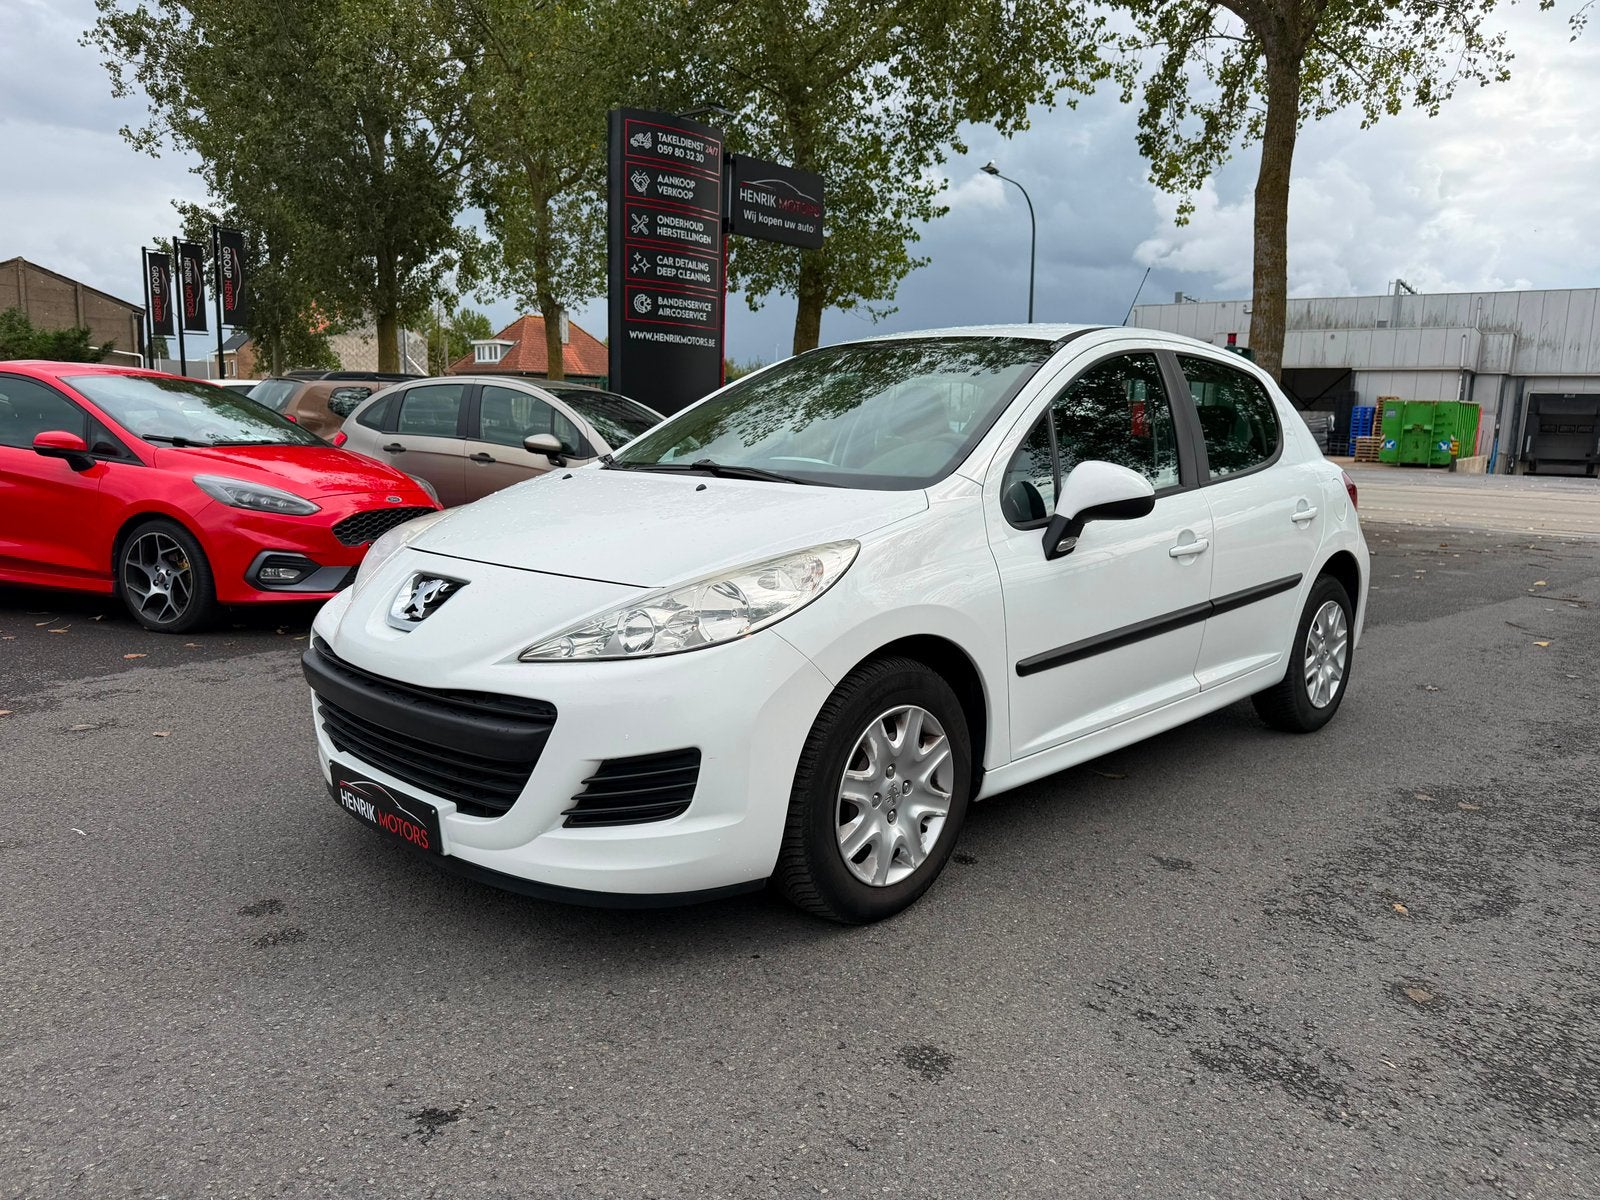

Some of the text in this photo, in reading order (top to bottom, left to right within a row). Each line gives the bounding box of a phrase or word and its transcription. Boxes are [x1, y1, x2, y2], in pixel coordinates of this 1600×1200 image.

[657, 132, 704, 151] TAKELDIENST
[657, 144, 705, 163] 059 80 32 30
[657, 174, 696, 189] AANKOOP
[657, 185, 694, 200] VERKOOP
[740, 187, 820, 218] HENRIK MOTORS
[657, 215, 704, 231] ONDERHOUD
[743, 209, 757, 223] Wij
[758, 212, 783, 227] kopen
[784, 220, 796, 229] uw
[657, 226, 711, 244] HERSTELLINGEN
[656, 255, 709, 272] CAR DETAILING
[222, 246, 234, 311] GROUP HENRIK
[656, 266, 711, 283] DEEP CLEANING
[151, 266, 162, 322] GROUP HENRIK
[183, 257, 195, 319] HENRIK MOTORS
[657, 296, 712, 312] BANDENSERVICE
[658, 308, 707, 321] AIRCOSERVICE
[629, 330, 716, 347] WWW.HENRIKMOTORS.BE
[340, 788, 429, 849] HENRIK MOTORS
